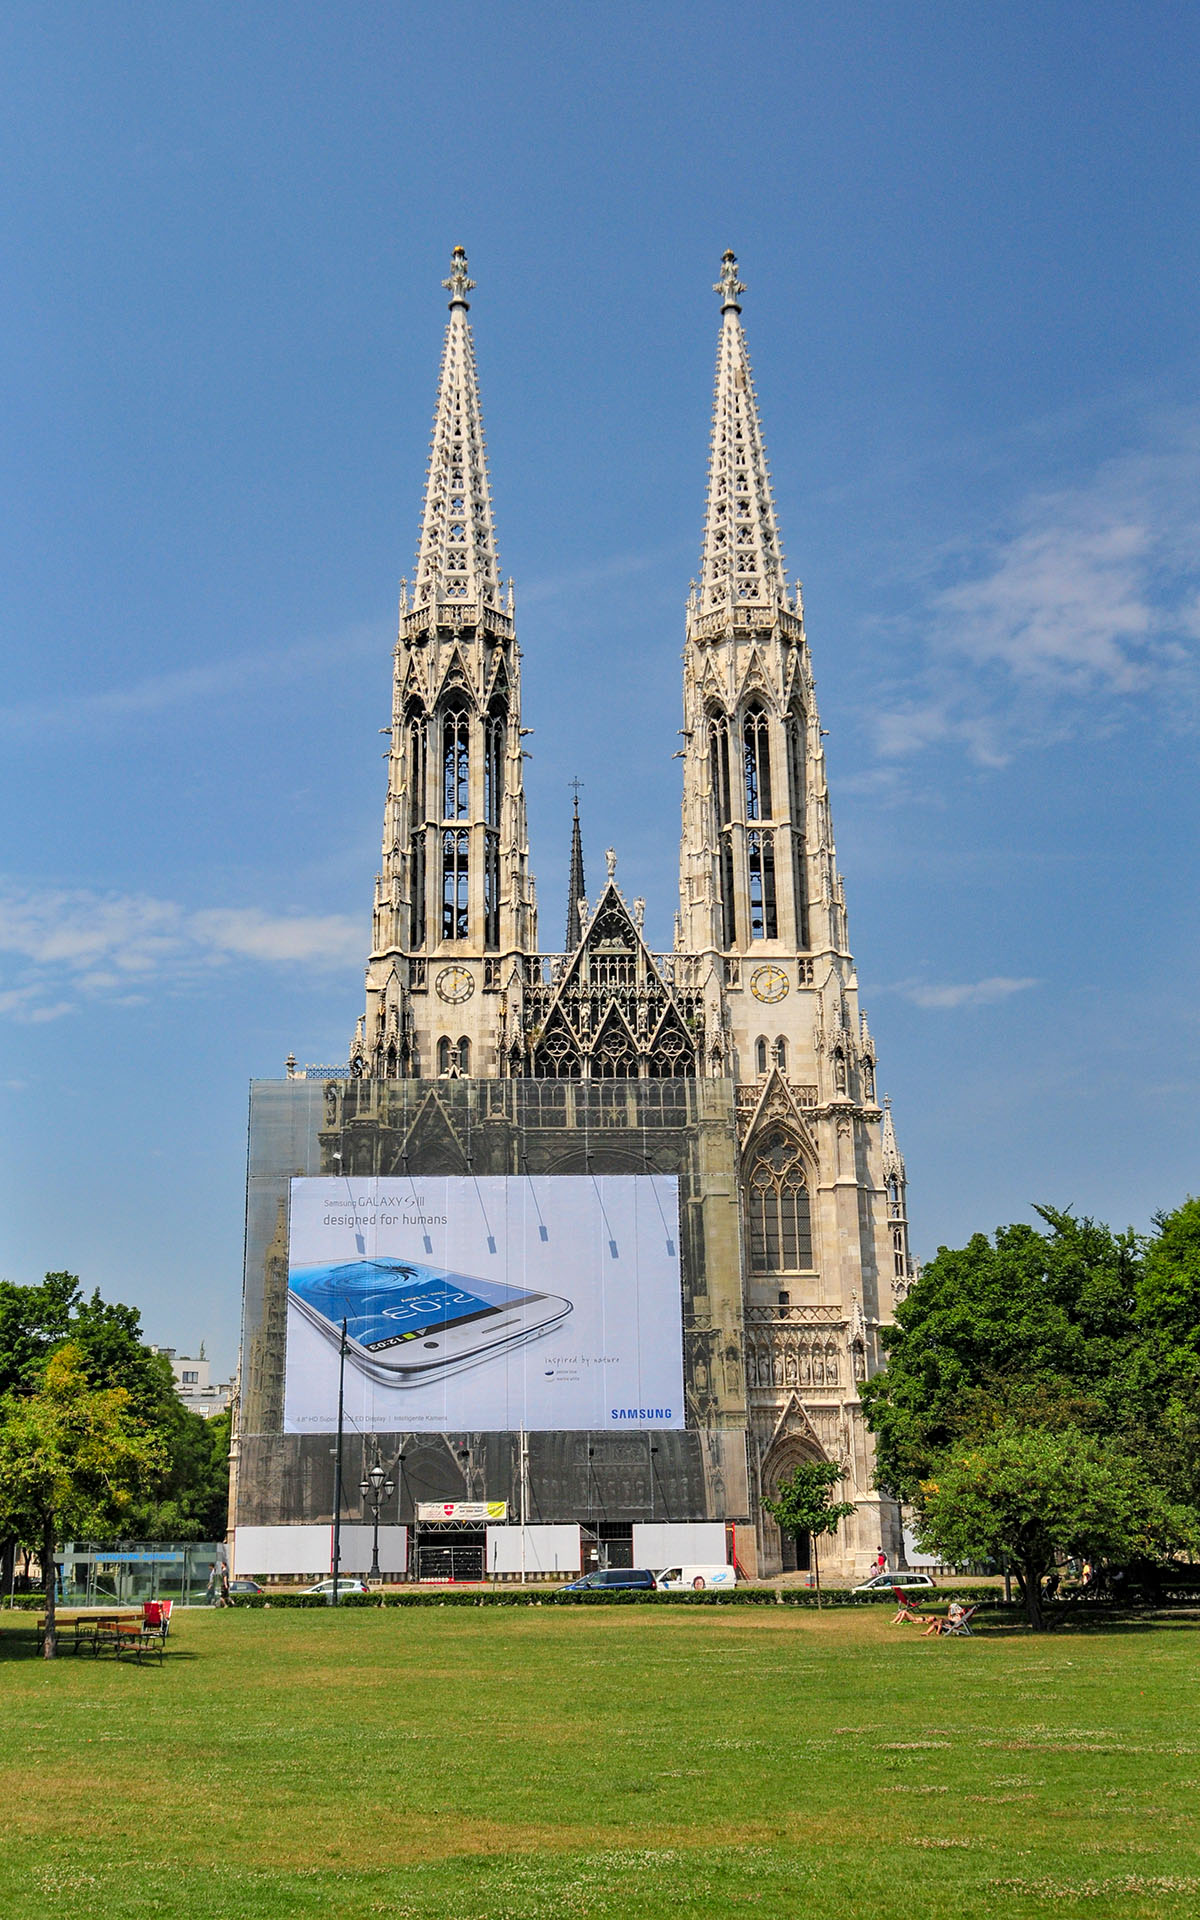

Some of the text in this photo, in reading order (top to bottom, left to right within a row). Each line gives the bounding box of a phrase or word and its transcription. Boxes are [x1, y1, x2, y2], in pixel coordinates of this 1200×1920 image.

[324, 1199, 356, 1209] Samsung
[358, 1196, 402, 1207] GALAXY
[323, 1214, 448, 1228] designed for humans
[369, 1337, 404, 1351] 12:03
[545, 1353, 620, 1367] inspired by nature
[611, 1408, 672, 1419] SAMSUNG
